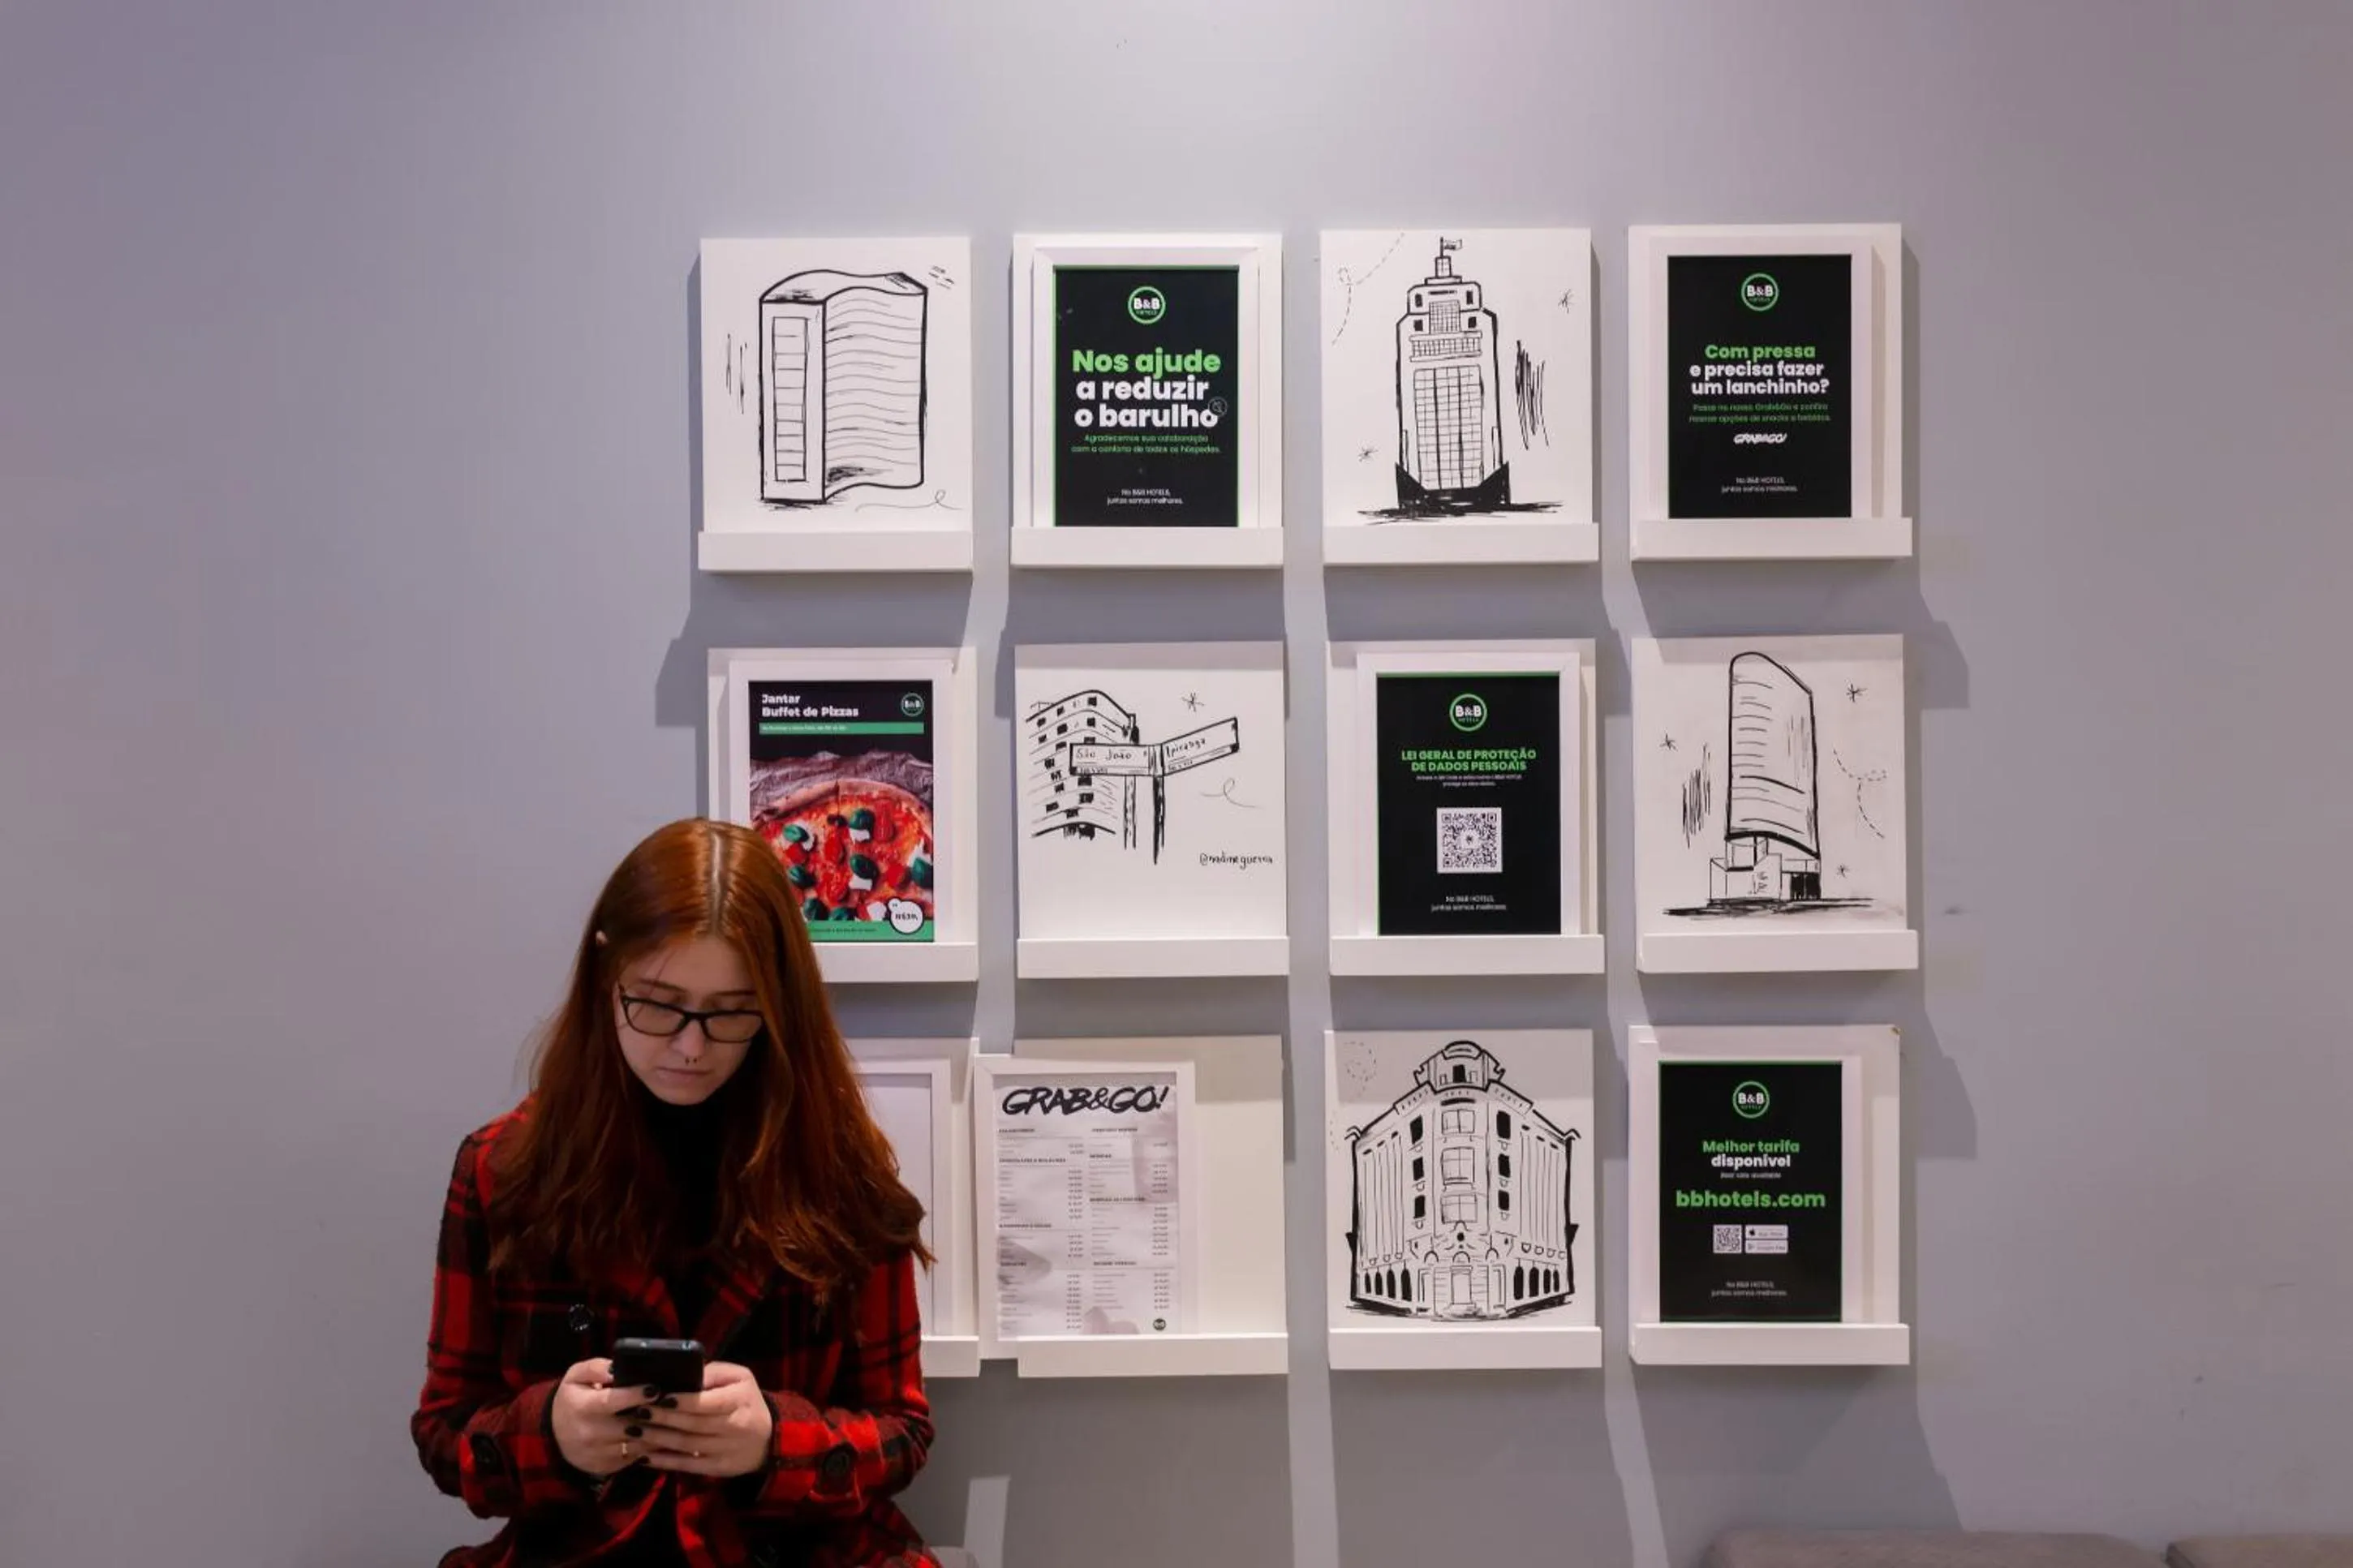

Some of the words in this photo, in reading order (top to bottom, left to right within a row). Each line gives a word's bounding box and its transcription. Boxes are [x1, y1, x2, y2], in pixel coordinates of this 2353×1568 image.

[1747, 286, 1774, 297] B&B
[1133, 298, 1160, 309] B&B
[1705, 346, 1748, 359] Com
[1753, 346, 1816, 363] pressa
[1072, 350, 1129, 372] Nos
[1135, 347, 1221, 379] ajude
[1689, 364, 1701, 376] e
[1705, 361, 1774, 380] precisa
[1777, 361, 1824, 376] fazer
[1076, 380, 1095, 400] a
[1102, 375, 1209, 400] reduzir
[1692, 381, 1723, 394] um
[1727, 378, 1830, 394] lanchinho?
[1074, 408, 1094, 427] o
[1099, 403, 1219, 427] barulho
[762, 694, 801, 704] Jantar
[762, 707, 801, 717] Buffet
[803, 707, 818, 717] de
[821, 706, 859, 717] Pizzas
[1455, 706, 1482, 717] B&B
[1401, 750, 1417, 761] LEI
[1419, 750, 1455, 760] GERAL
[1457, 750, 1472, 760] DE
[1474, 746, 1537, 762] PROTEÇÃO
[1411, 762, 1426, 771] DE
[1428, 762, 1469, 771] DADOS
[1471, 761, 1527, 771] PESSOAIS
[1002, 1085, 1170, 1116] GRAB&GO!
[1738, 1093, 1765, 1104] B&B
[1702, 1141, 1755, 1153] Melhor
[1757, 1140, 1800, 1153] tarifa
[1711, 1153, 1791, 1171] disponível
[1675, 1190, 1826, 1208] bbhotels.com
